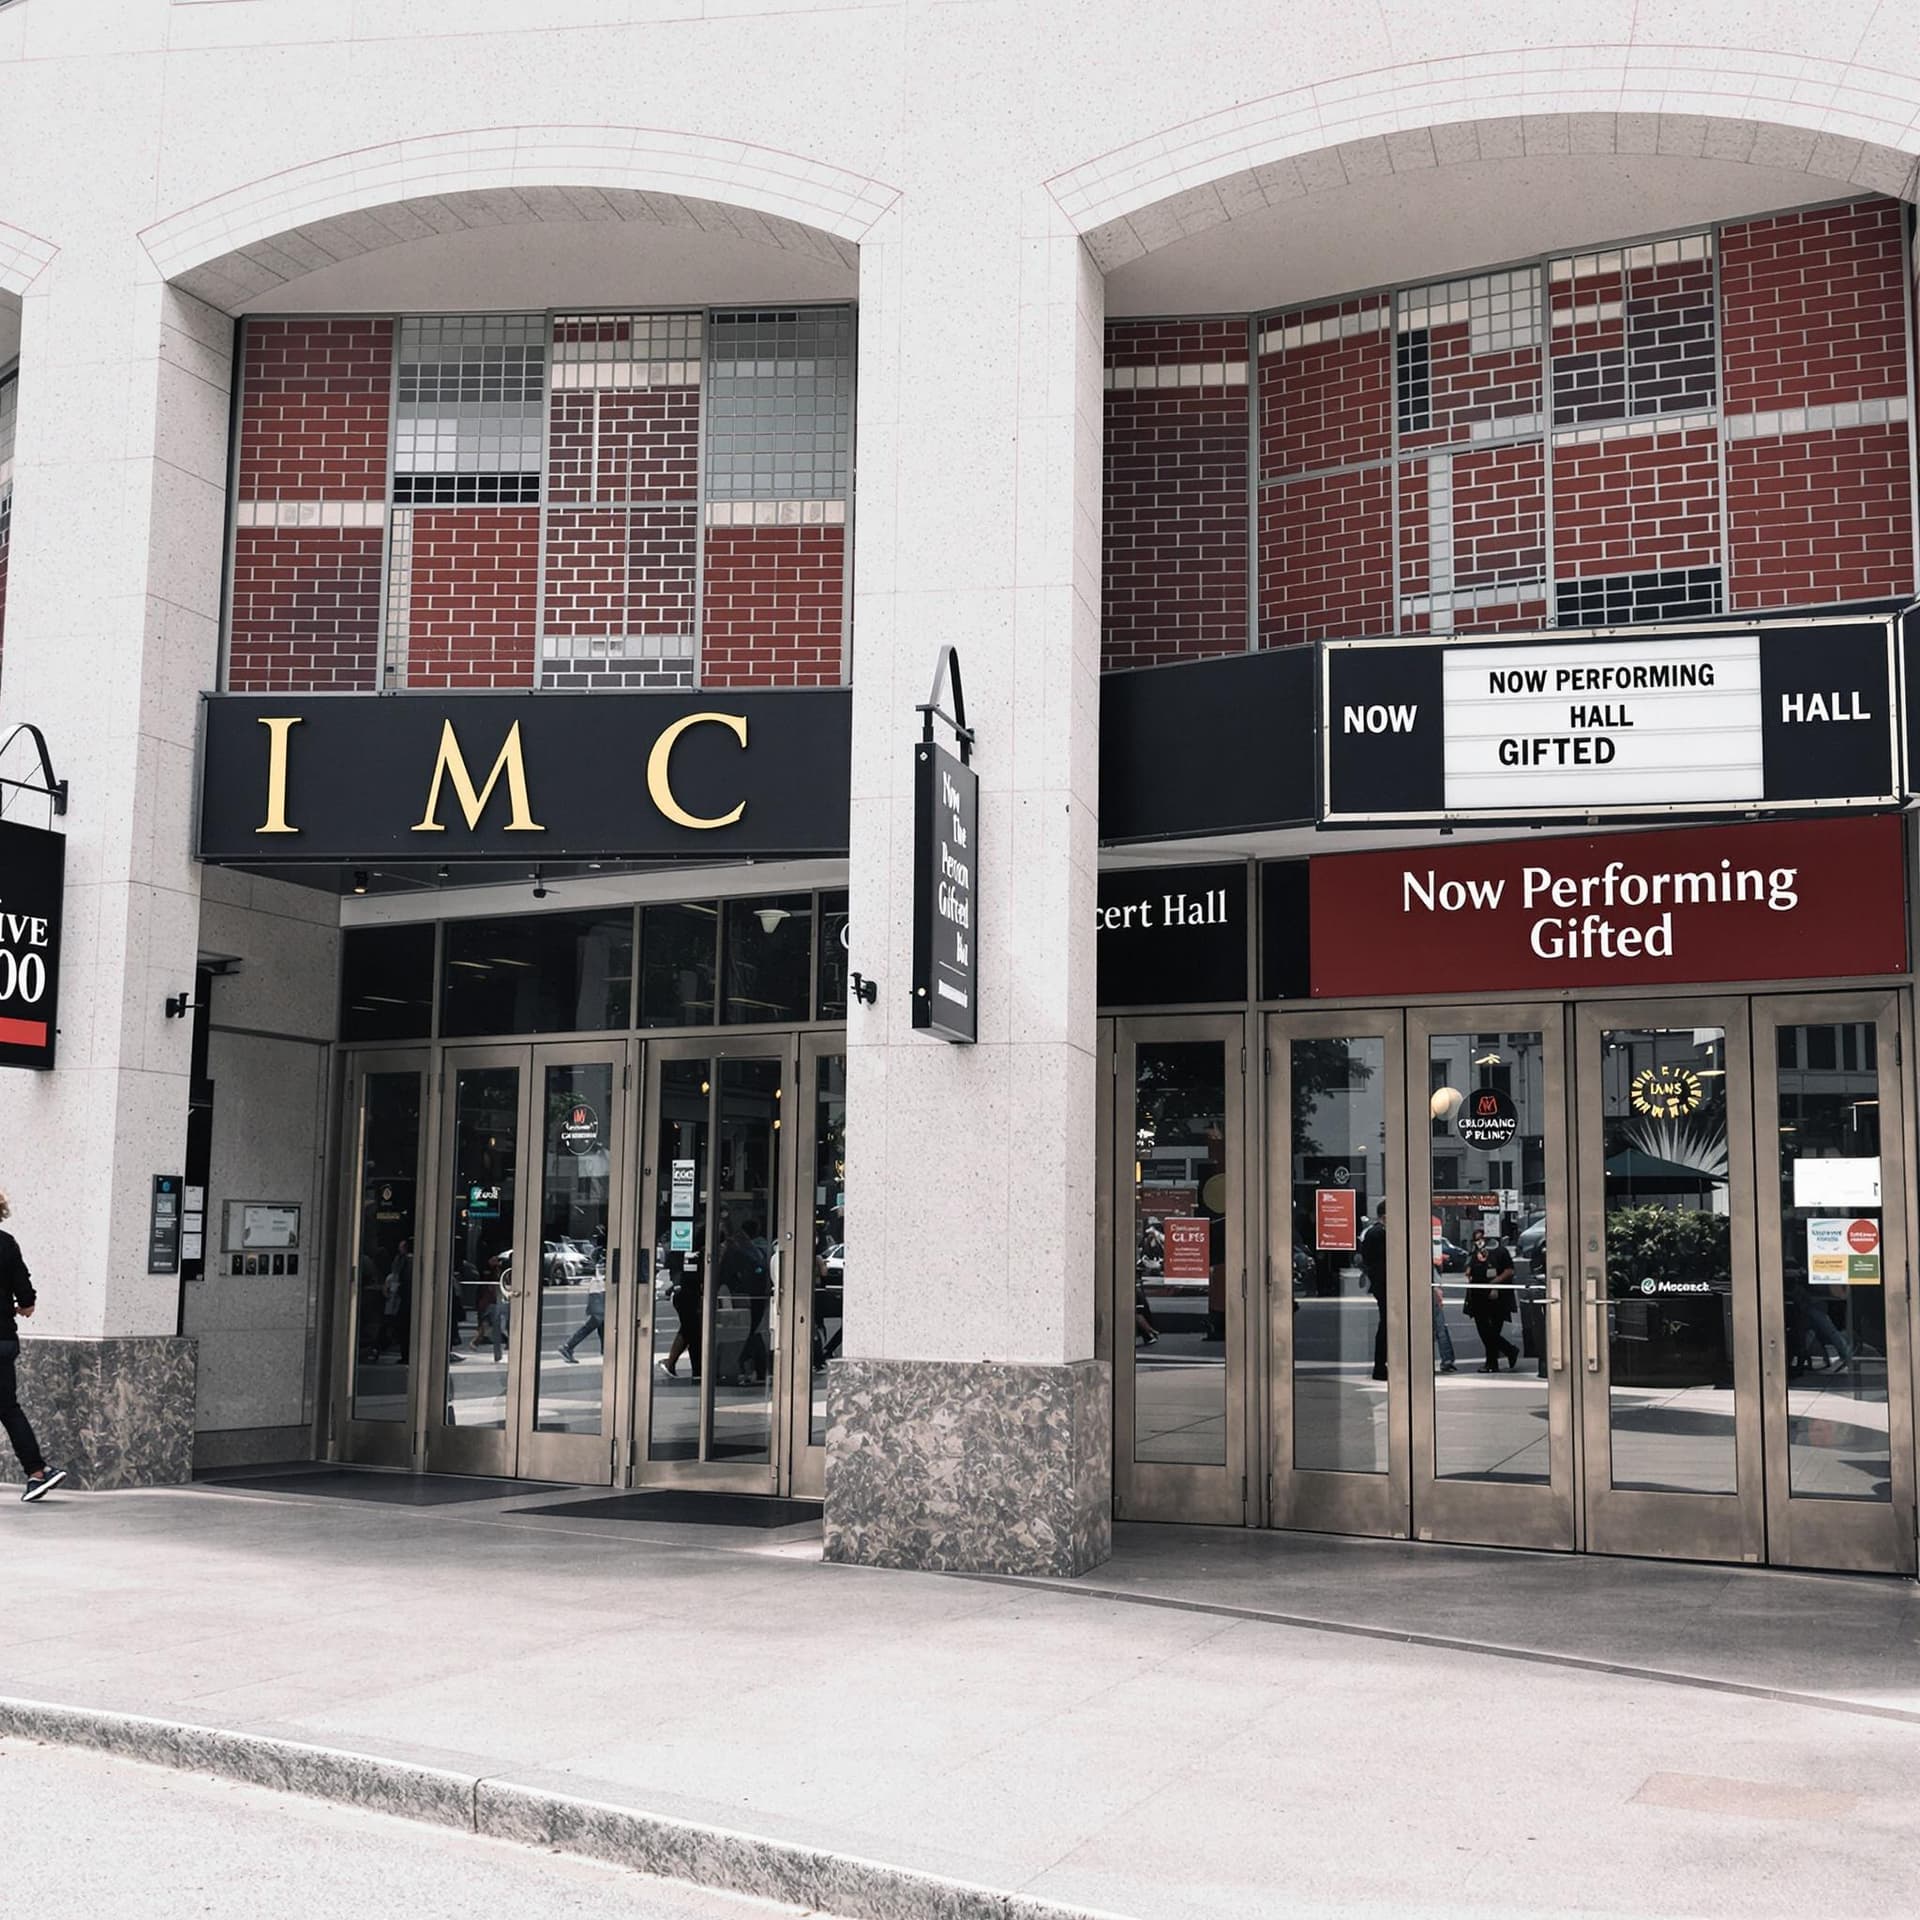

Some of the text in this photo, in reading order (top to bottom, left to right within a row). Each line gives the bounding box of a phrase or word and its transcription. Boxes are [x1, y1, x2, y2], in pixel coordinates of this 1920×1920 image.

[1489, 663, 1715, 694] NOW PERFORMING
[1343, 704, 1419, 734] NOW
[1570, 704, 1634, 729] HALL
[1781, 691, 1872, 723] HALL
[1498, 736, 1616, 767] GIFTED
[1403, 858, 1798, 912] Now Performing
[1162, 888, 1228, 927] Hall
[1530, 911, 1673, 959] Gifted
